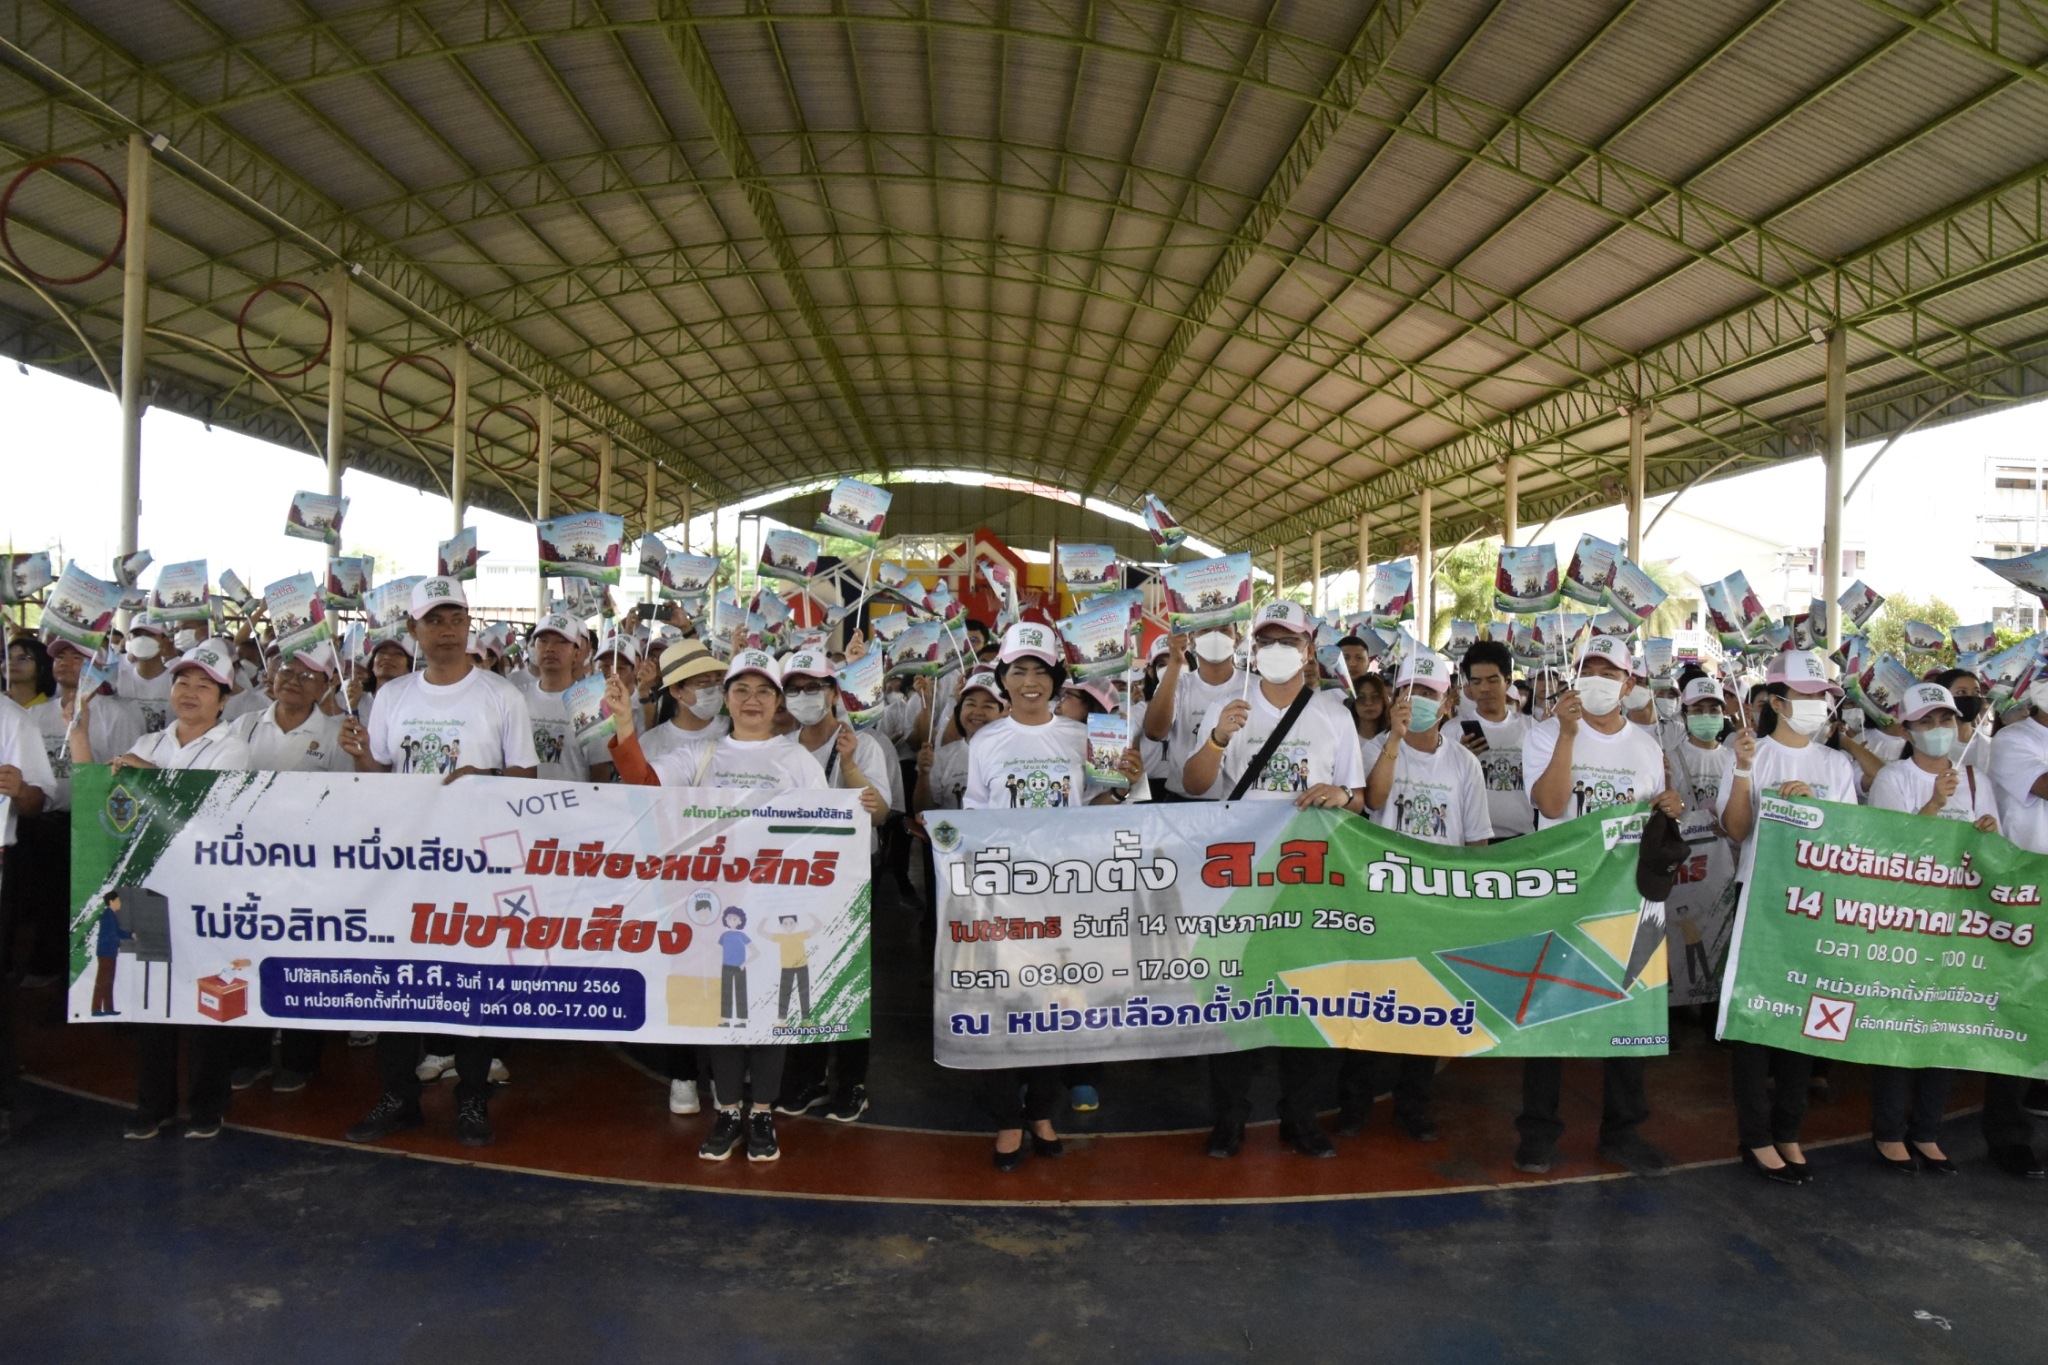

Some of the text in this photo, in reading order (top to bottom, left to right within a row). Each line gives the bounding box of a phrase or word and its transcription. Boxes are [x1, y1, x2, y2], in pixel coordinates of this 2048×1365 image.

[507, 789, 579, 818] VOTE
[682, 805, 853, 820] #ไทยโหวต คนไทยพร้อมใช้สิทธิ
[195, 823, 316, 868] หนึ่งคน
[525, 836, 840, 887] มีเพียงหนึ่งสิทธิ
[950, 830, 1578, 899] เลือกตั้ง ส.ส. กันเถอะ
[1989, 884, 2043, 905] ส.ส.
[191, 892, 694, 955] ไม่ซื้อสิทธิ... ไม่ขายเสียง
[950, 907, 1377, 942] ไปใช้สิทธิ วันที่ 14 พฤษภาคม 2566
[1786, 886, 1824, 919] 14
[1957, 908, 2036, 947] 2566
[1816, 938, 1859, 959] เวลา
[1866, 944, 1918, 965] 08.00
[1972, 954, 1987, 970] น.
[284, 963, 621, 994] ไปใช้สิทธิเลือกตั้ง ส.ส. วันที่ 14 พฤษภาคม 2566
[951, 968, 1009, 990] เวลา
[1019, 962, 1103, 987] 08.00
[1137, 958, 1210, 981] 17.00
[1220, 959, 1244, 978] น.
[1787, 970, 1808, 986] ณ
[285, 989, 627, 1018] ณ หน่วยเลือกตั้งที่ท่านมีชื่ออยู่ เวลา 08.00-17.00 น.
[951, 979, 1477, 1037] ณ หน่วยเลือกตั้งที่ท่านมีชื่ออยู่
[1748, 996, 1803, 1018] เข้าคูหา
